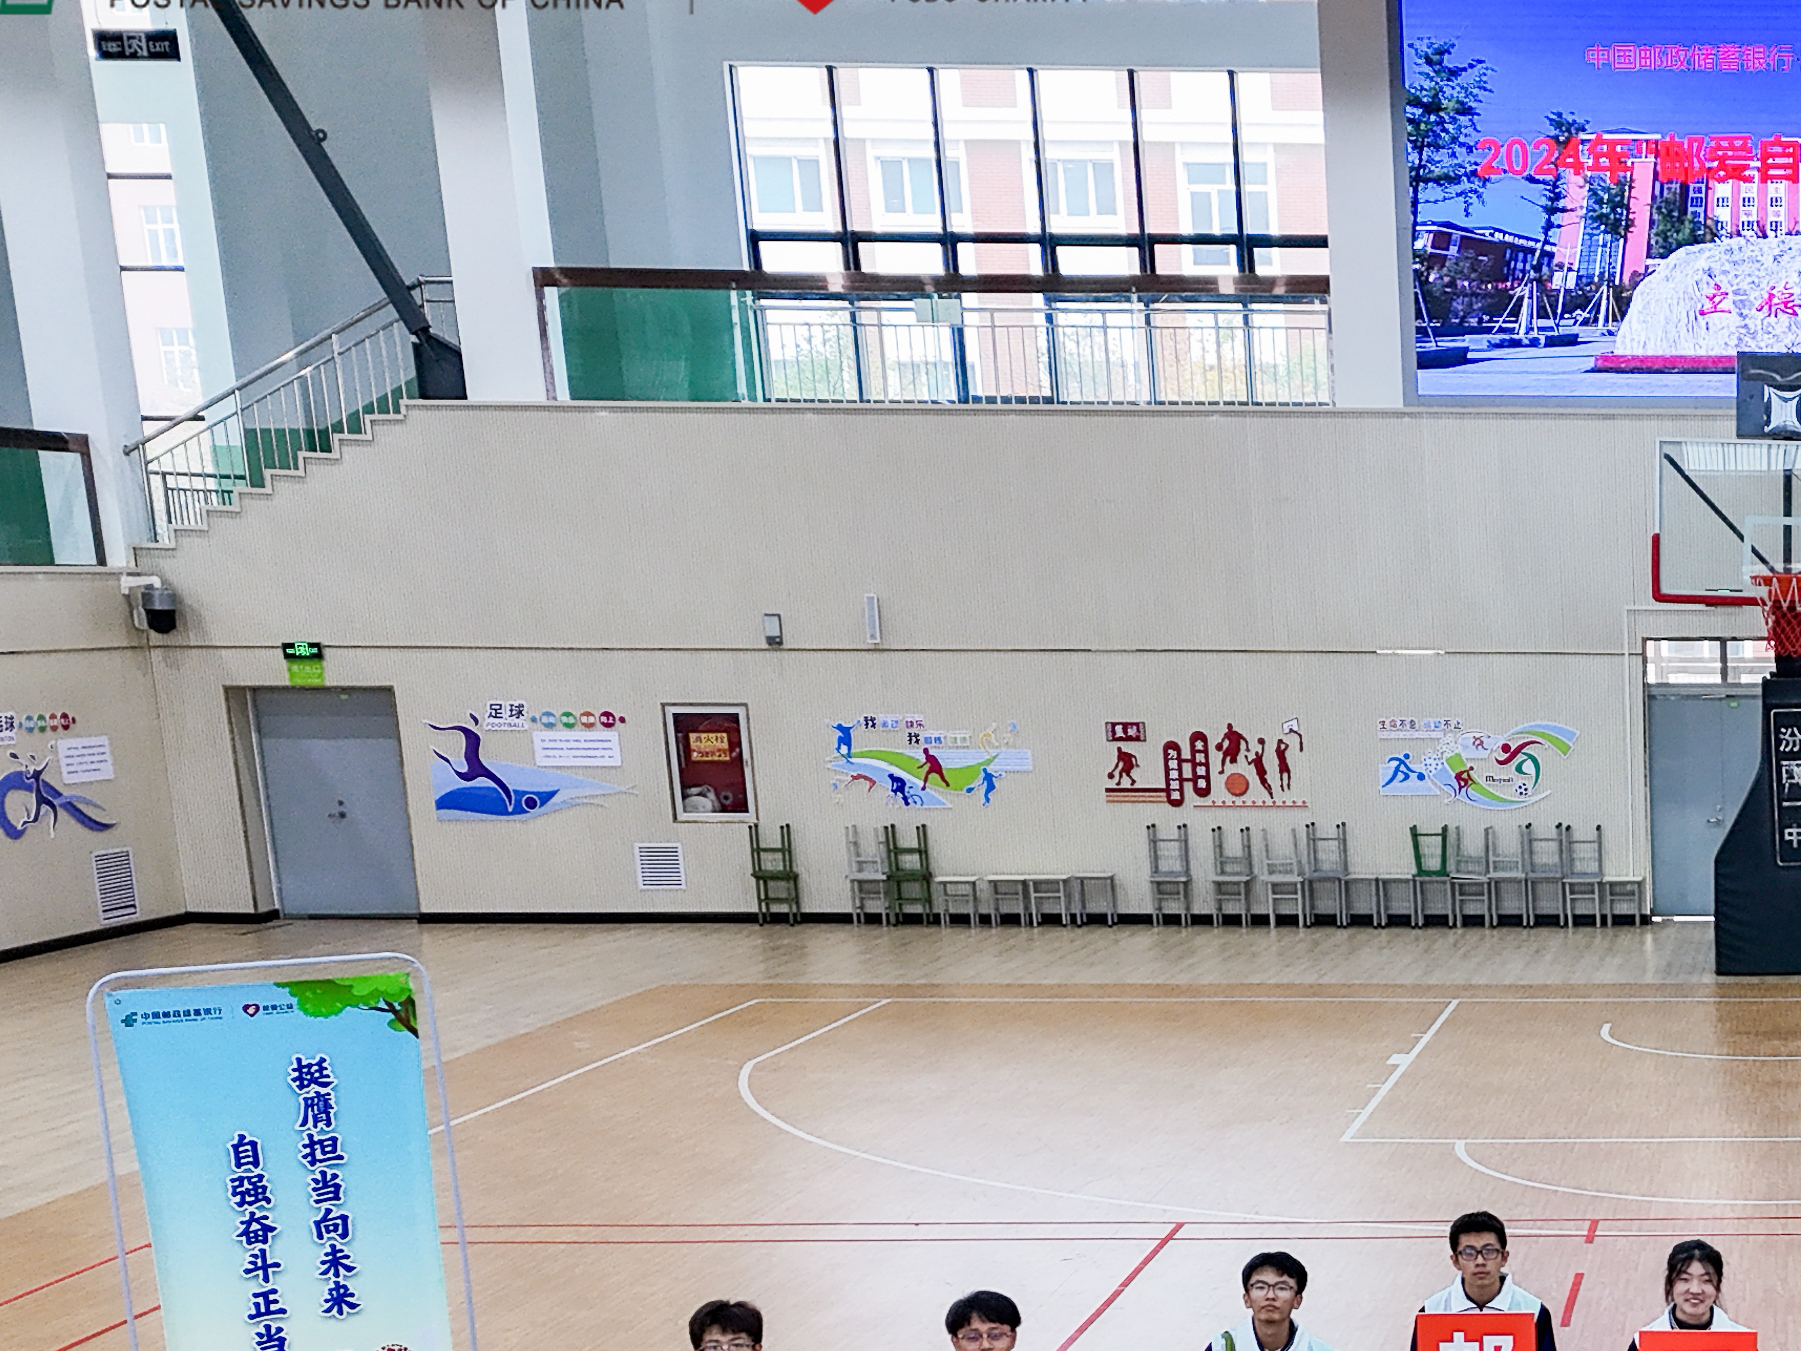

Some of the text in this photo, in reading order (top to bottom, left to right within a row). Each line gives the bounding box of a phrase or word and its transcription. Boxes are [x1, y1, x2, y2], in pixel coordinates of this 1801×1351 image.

[1586, 43, 1795, 72] 中国邮政储蓄银行
[487, 703, 525, 719] 足球
[290, 1056, 362, 1317] 挺膺担当向未来
